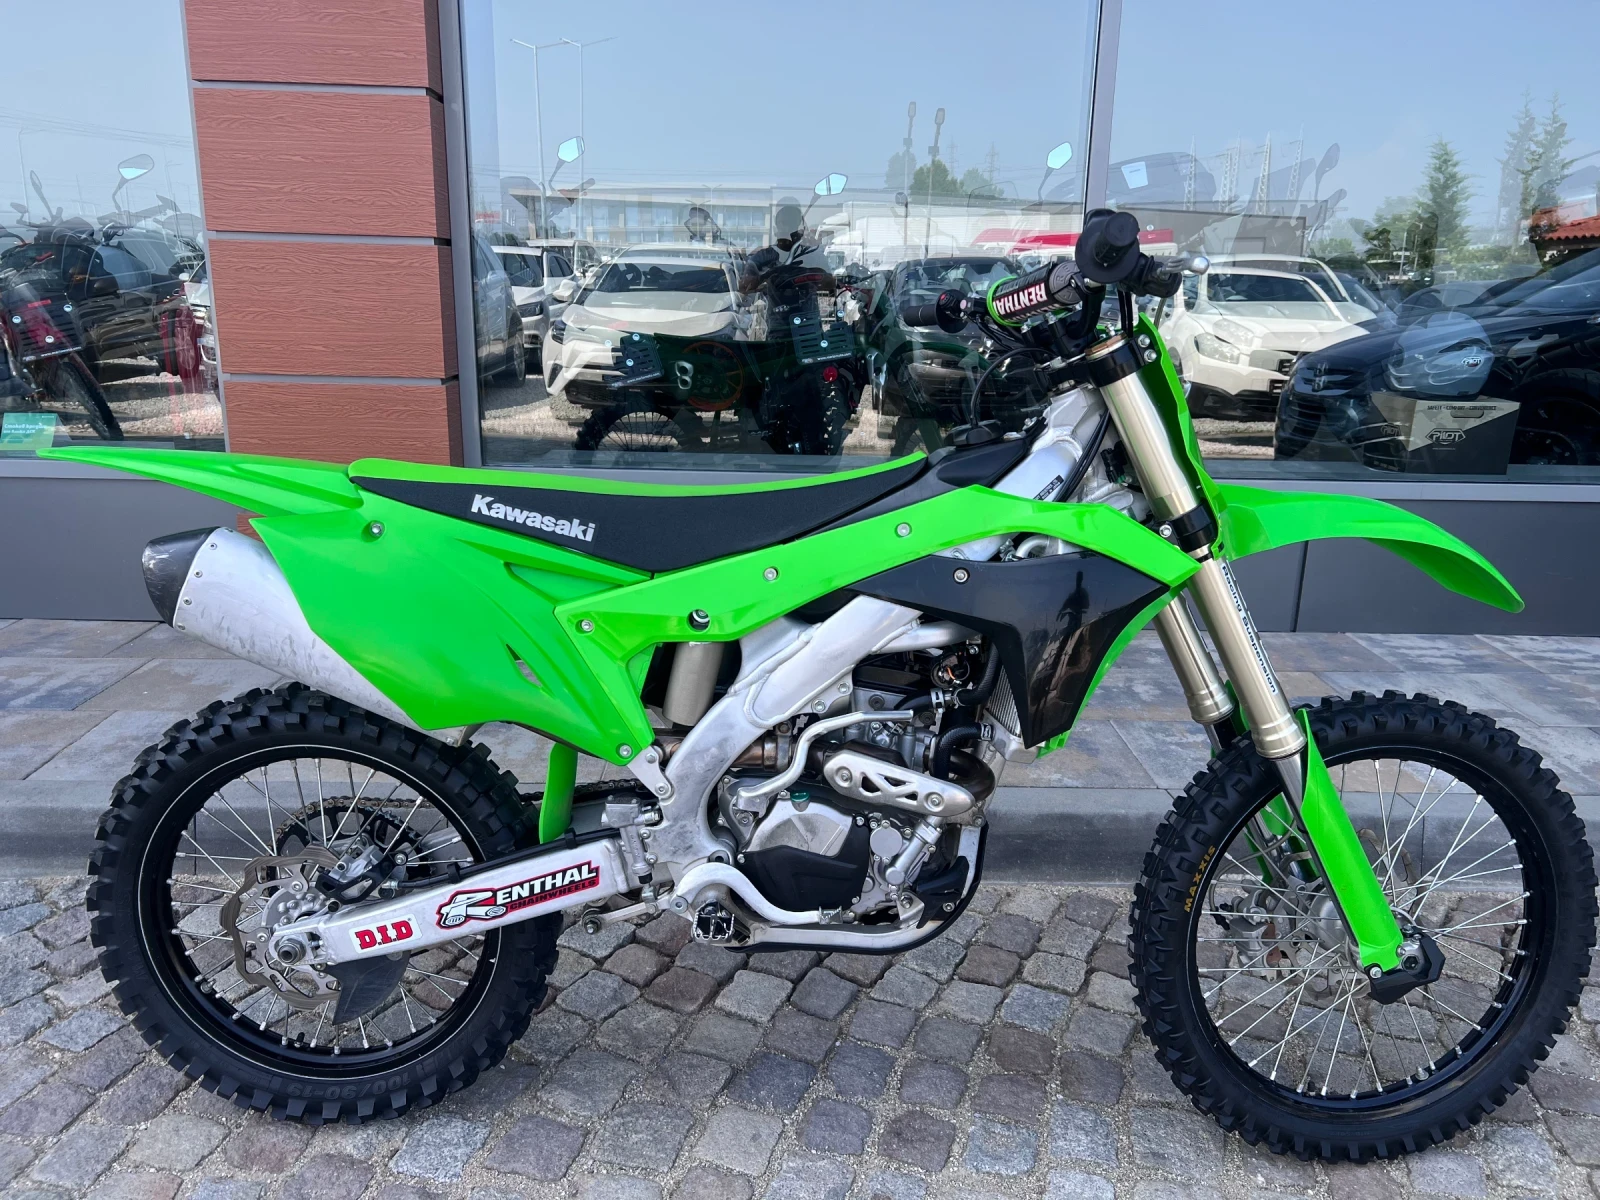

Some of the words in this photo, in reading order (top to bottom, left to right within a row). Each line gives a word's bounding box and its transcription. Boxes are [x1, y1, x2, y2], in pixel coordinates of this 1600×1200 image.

[1432, 430, 1461, 441] PILOT
[471, 494, 596, 542] Kawasaki
[1221, 564, 1243, 612] Racing
[1242, 616, 1277, 693] Suspension
[509, 879, 597, 910] CHAINWHEELS
[1184, 845, 1216, 913] MAXXIS
[355, 920, 414, 950] D.I.D
[286, 1075, 410, 1100] 100/90-19
